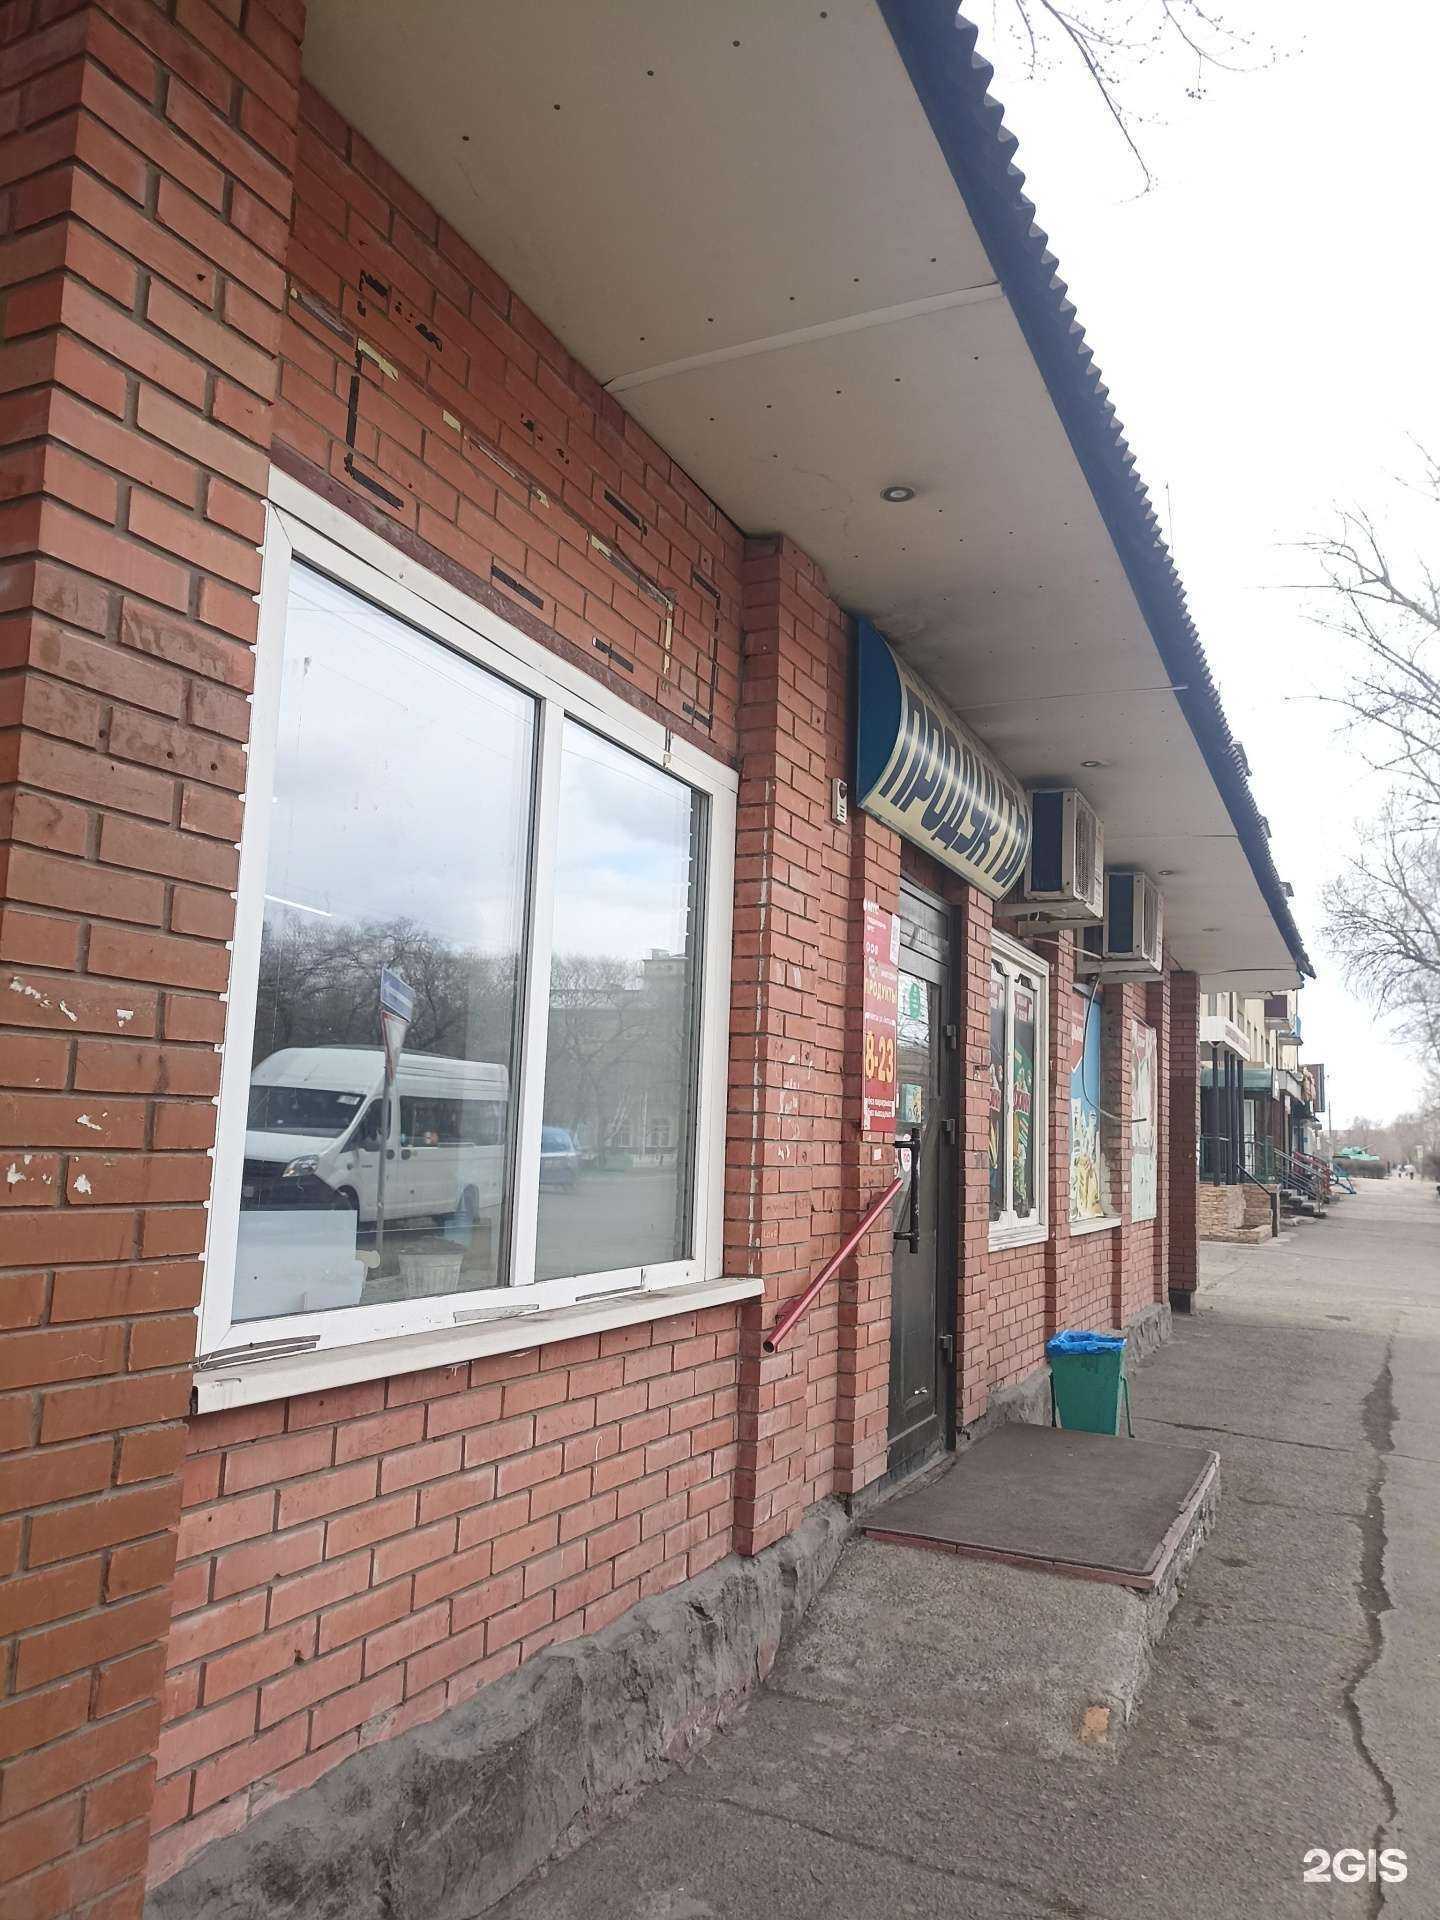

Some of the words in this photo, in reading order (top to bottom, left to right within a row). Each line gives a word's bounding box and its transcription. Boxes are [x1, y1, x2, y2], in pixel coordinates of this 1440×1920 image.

[878, 685, 1029, 889] ПРОДУКТЫ
[864, 977, 897, 1004] ПРОДУКТЫ
[865, 1031, 893, 1083] 8-23
